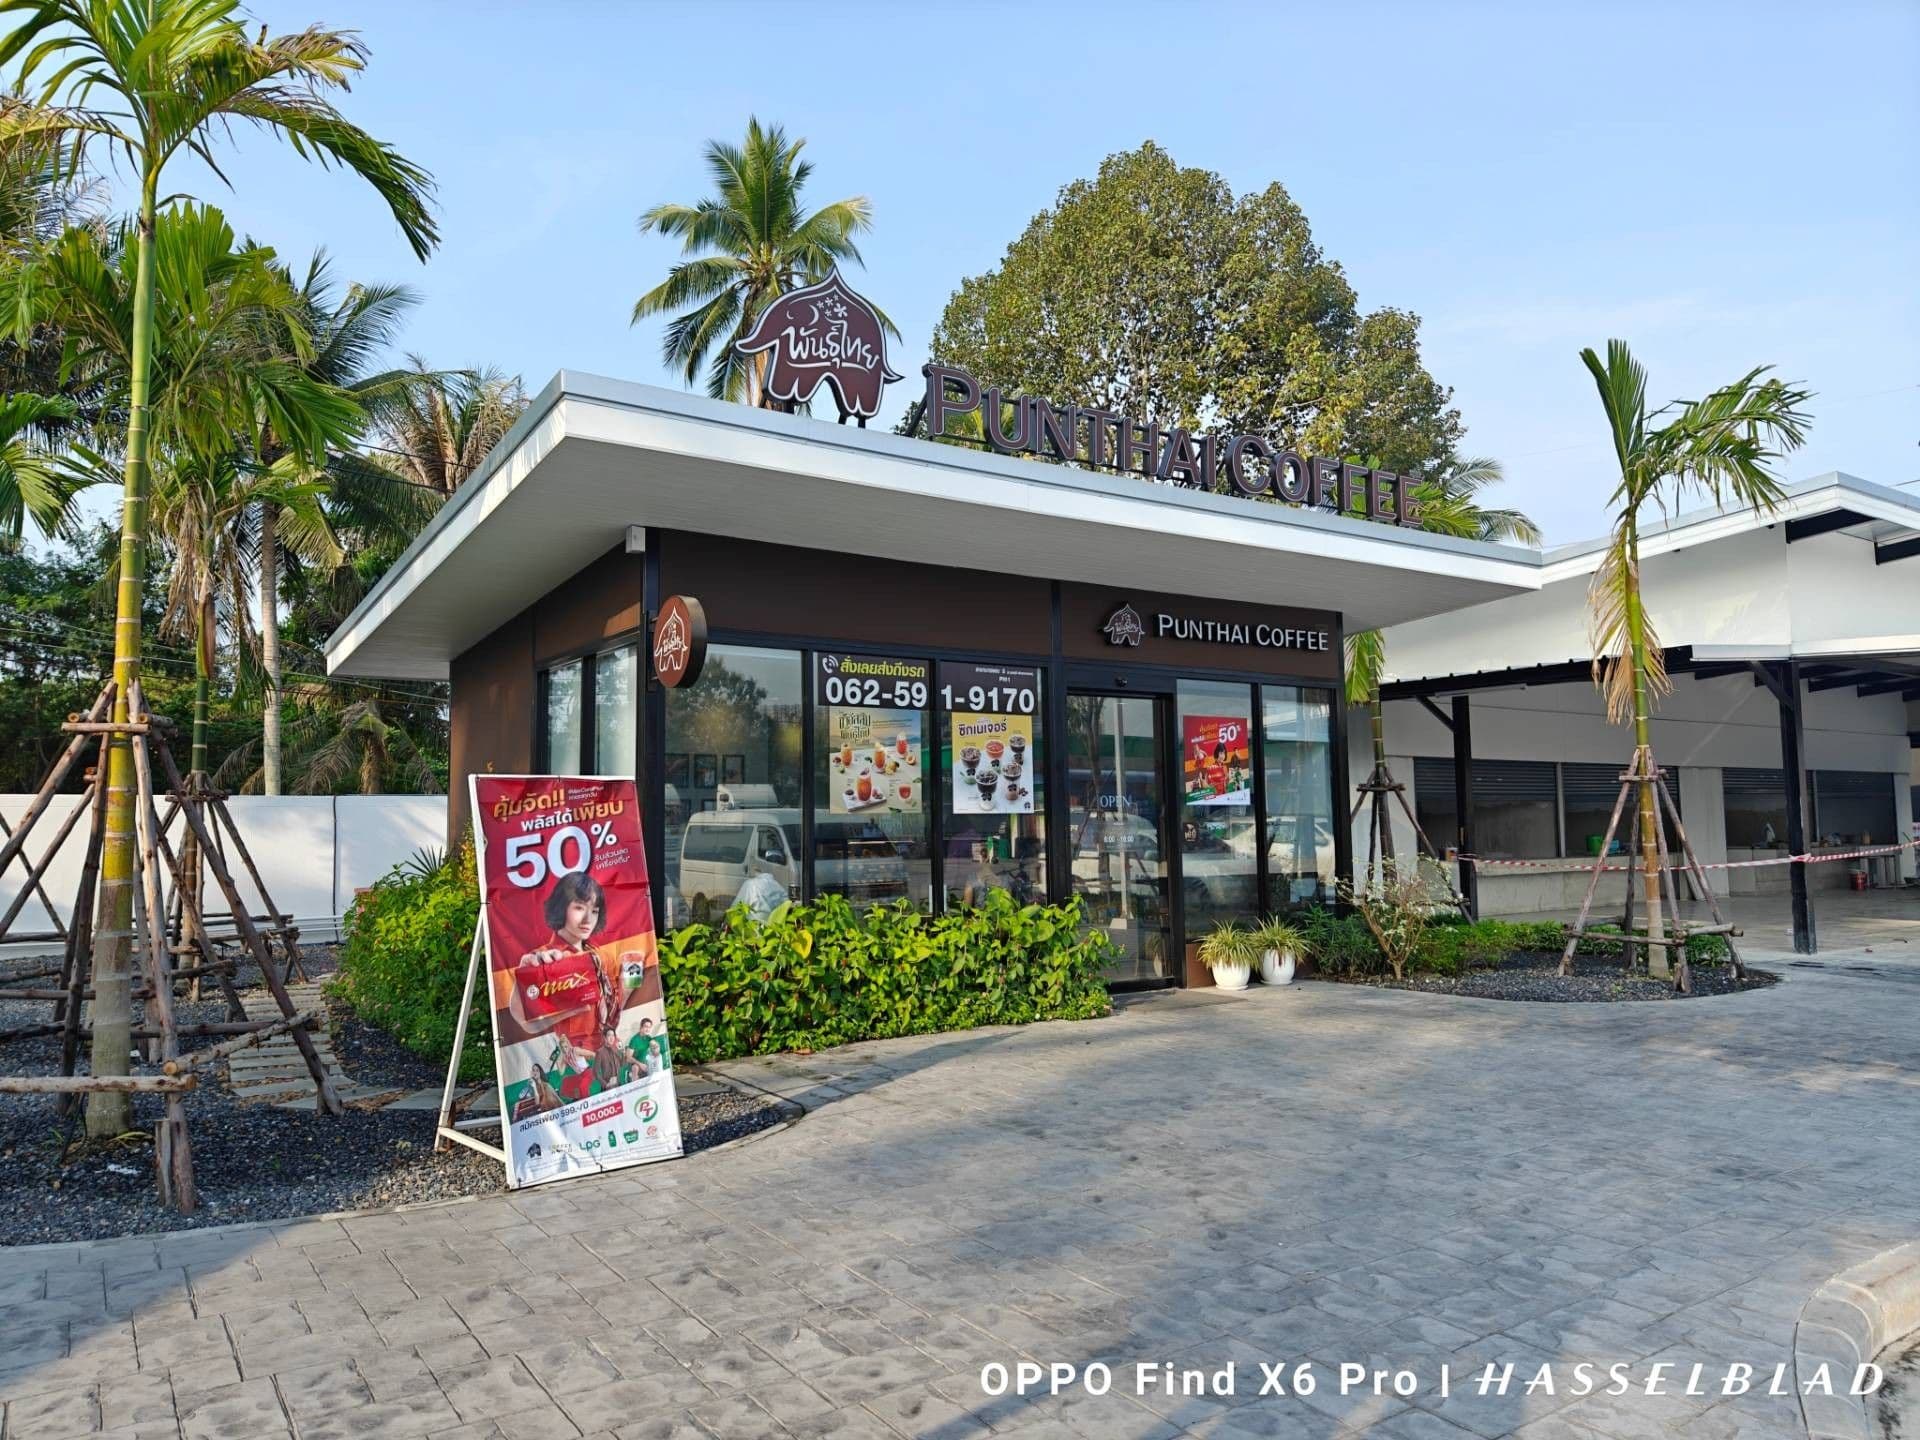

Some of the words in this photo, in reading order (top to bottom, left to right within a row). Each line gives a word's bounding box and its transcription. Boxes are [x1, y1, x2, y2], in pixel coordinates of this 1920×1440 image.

[781, 315, 880, 369] พันธุ์ไทย
[922, 363, 1216, 488] PUNTHAI
[1226, 434, 1424, 525] COFFEE
[1158, 614, 1249, 644] PUNTHAI
[1256, 624, 1329, 650] COFFEE
[840, 656, 924, 678] สั่งเลยส่งถึงรถ
[826, 677, 927, 708] 062-59
[941, 685, 1035, 713] 1-9170
[958, 717, 1007, 736] ซิกเนเจอร์
[493, 788, 566, 822] คุ้มจัด!!
